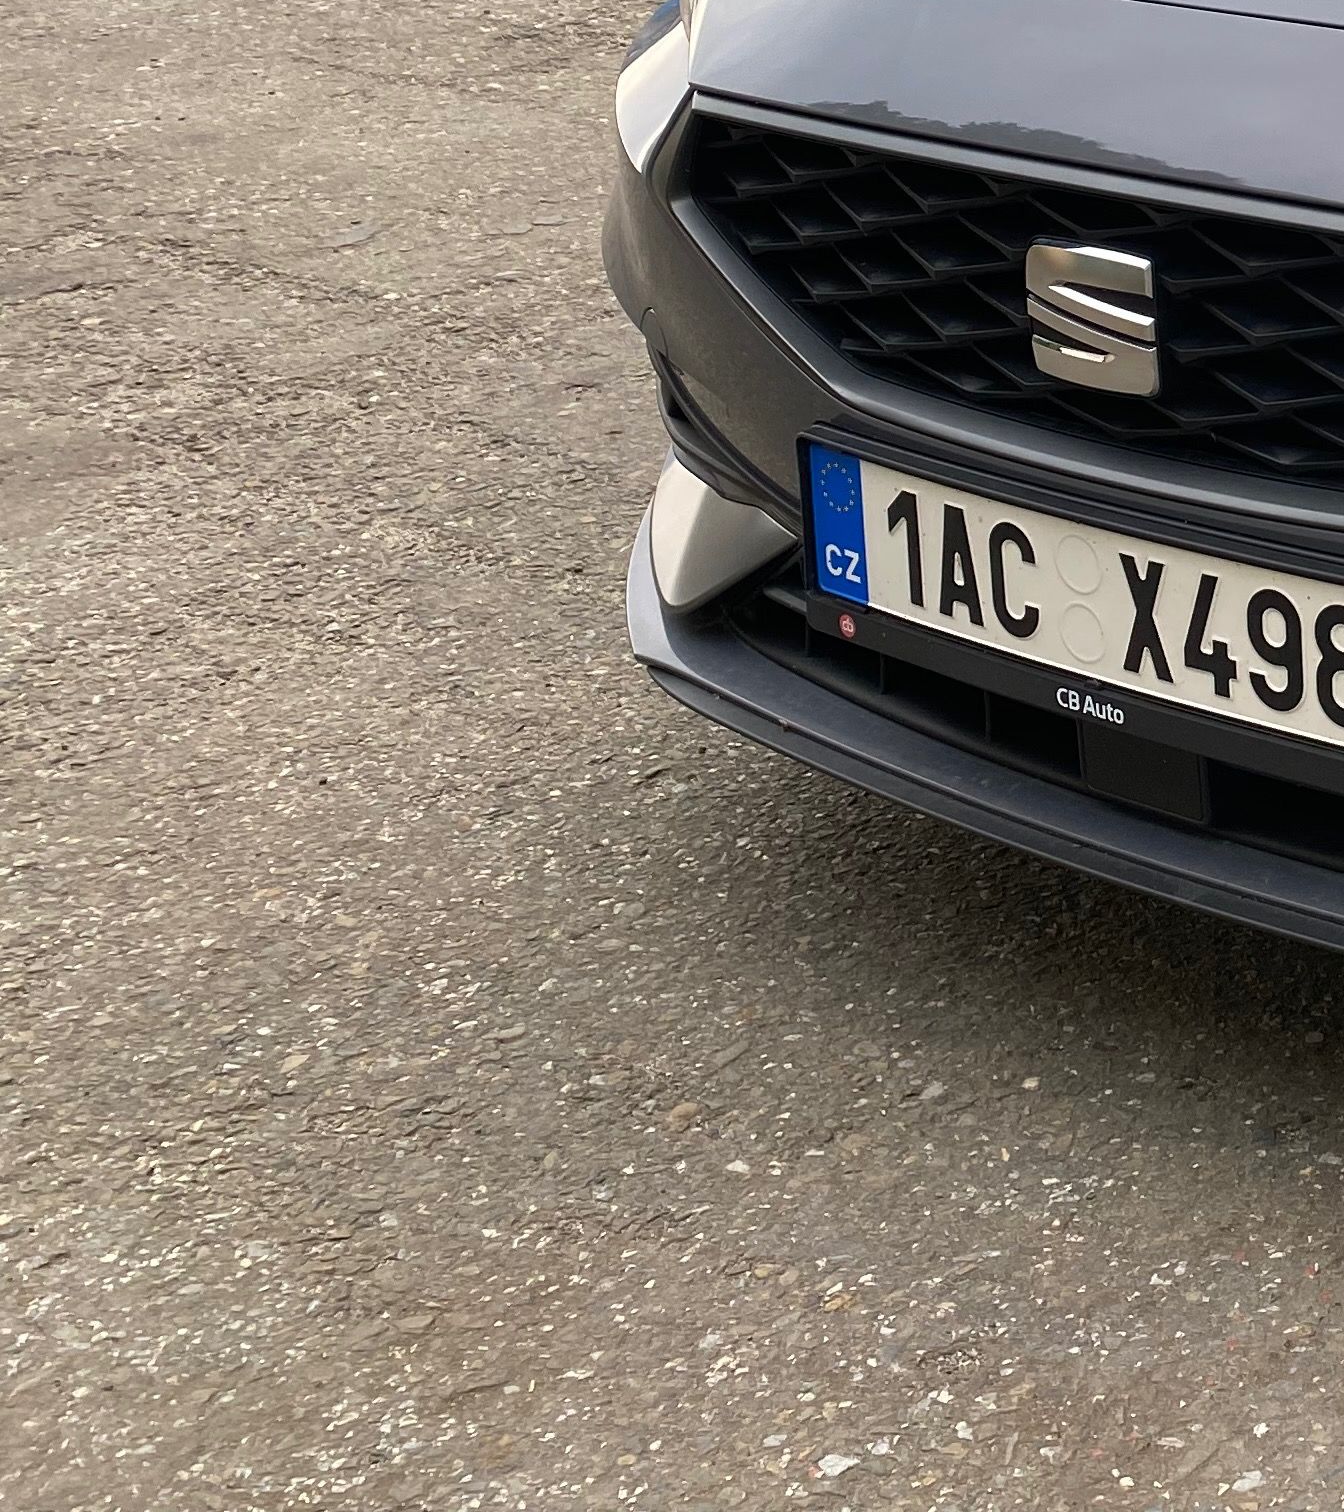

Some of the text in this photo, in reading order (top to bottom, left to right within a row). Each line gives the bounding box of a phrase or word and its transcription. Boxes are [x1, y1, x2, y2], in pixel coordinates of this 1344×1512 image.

[825, 543, 861, 584] CZ
[887, 490, 1041, 638] 1AC
[1056, 687, 1125, 725] CB Auto
